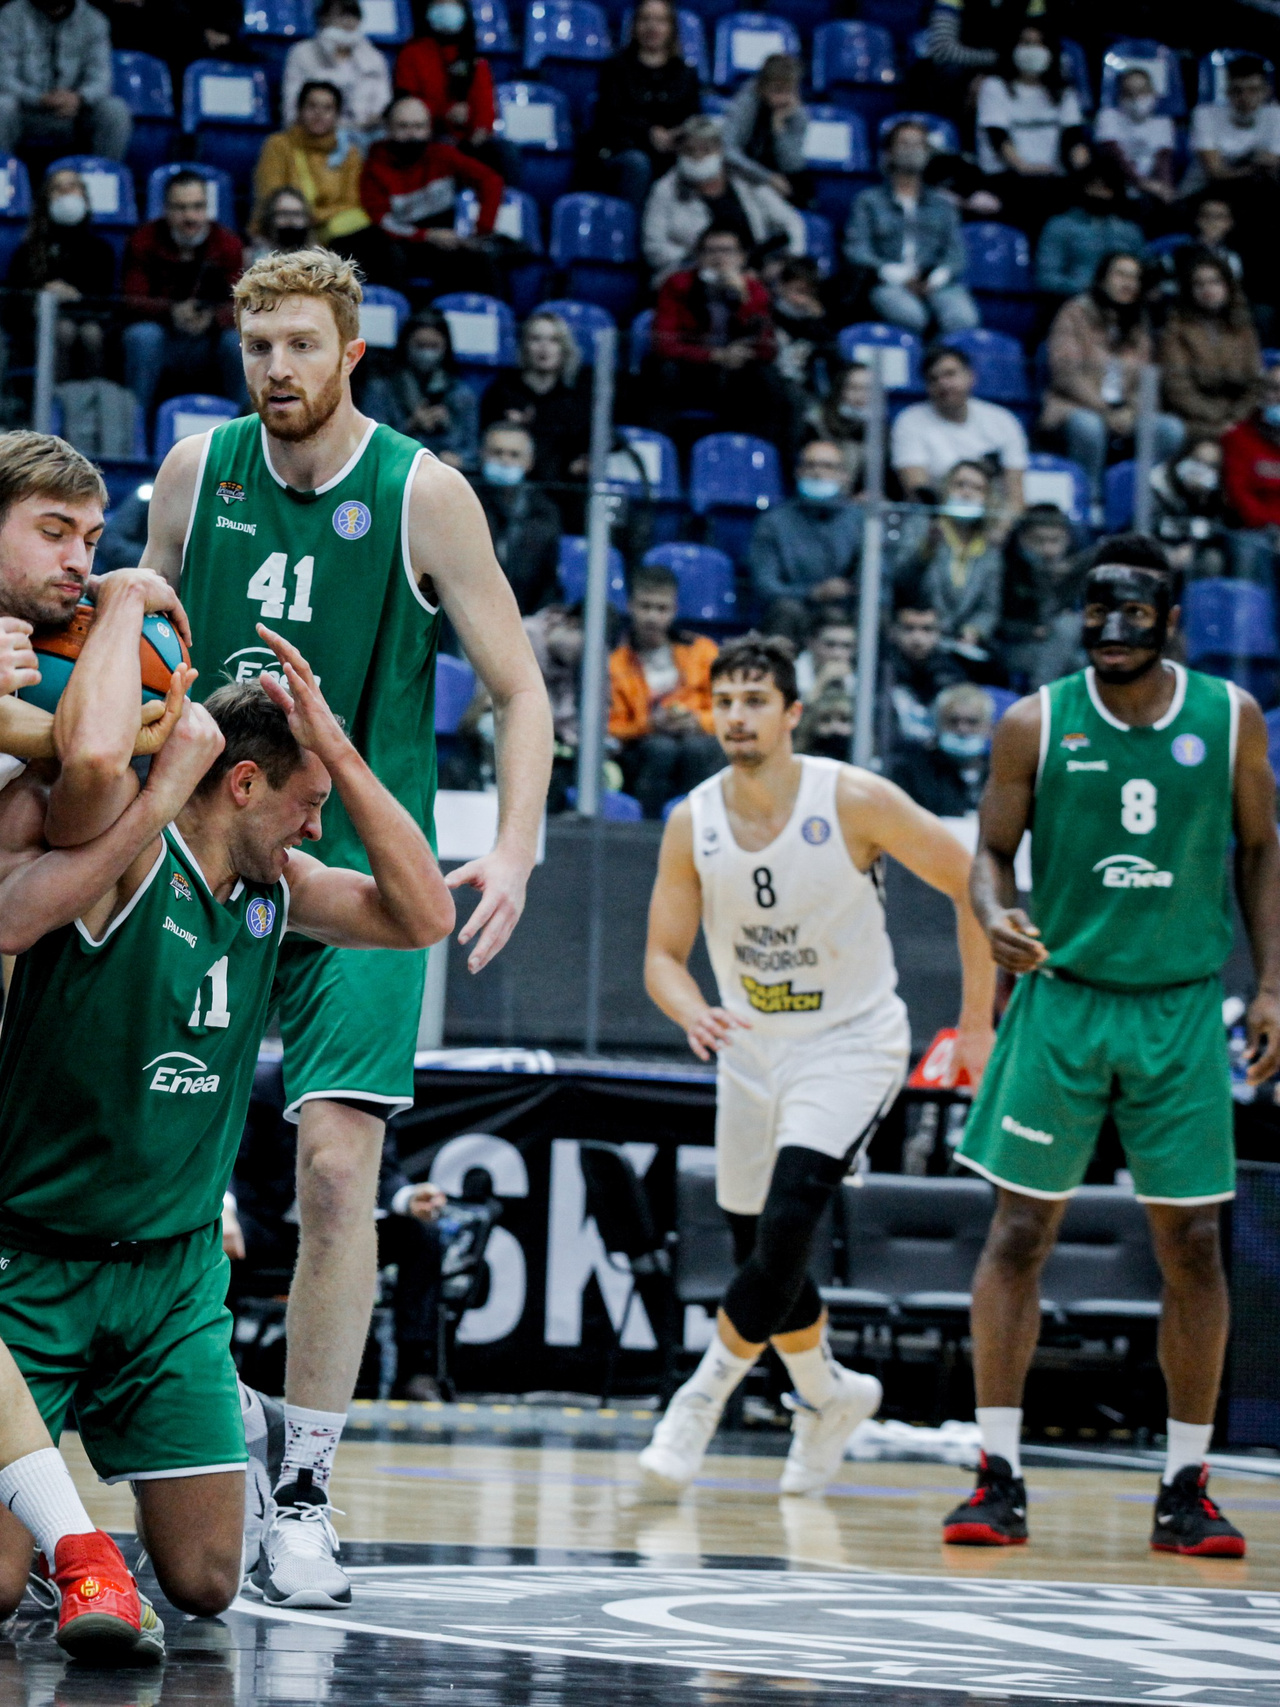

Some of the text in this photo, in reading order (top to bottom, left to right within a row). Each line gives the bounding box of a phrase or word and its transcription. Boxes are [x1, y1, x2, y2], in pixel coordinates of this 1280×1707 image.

[216, 516, 257, 536] SPALDING
[247, 552, 315, 623] 41
[1121, 778, 1158, 835] 8
[753, 867, 776, 909] 8
[162, 915, 198, 949] SPALDING
[149, 1066, 220, 1094] Enea
